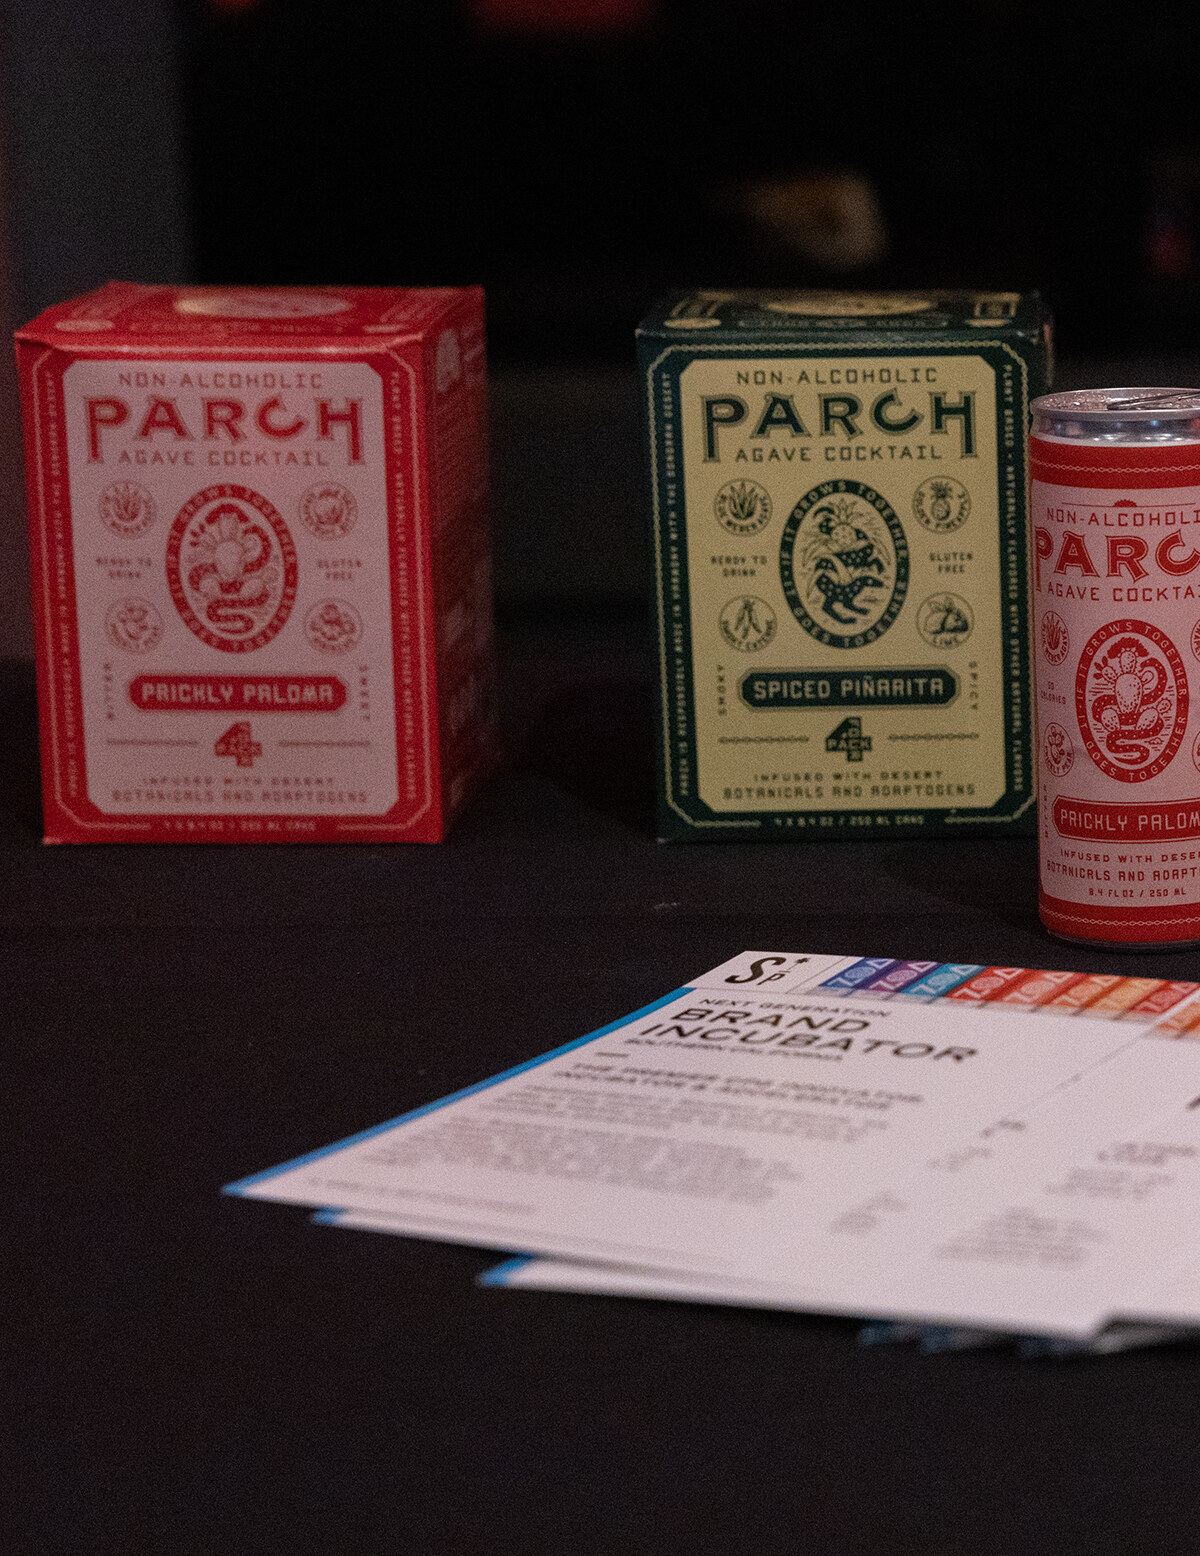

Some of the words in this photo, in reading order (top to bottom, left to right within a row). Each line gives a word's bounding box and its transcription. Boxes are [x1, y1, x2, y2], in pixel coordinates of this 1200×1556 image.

[118, 372, 323, 390] NON-ALCOHOLIC
[737, 367, 938, 386] NON-ALCOHOLIC
[84, 395, 366, 466] PARCH
[700, 387, 978, 464] PARCH
[118, 450, 196, 467] AGAVE
[207, 450, 329, 467] COCKTAIL
[735, 448, 812, 463] AGAVE
[825, 445, 942, 461] COCKTAIL
[1047, 581, 1100, 602] AGAVE
[1086, 621, 1133, 656] GROWS
[141, 683, 233, 703] PRICKLY
[243, 684, 334, 703] PALOMA
[753, 679, 831, 700] SPICED
[841, 675, 945, 699] PIÑARITA
[1086, 741, 1117, 777] GOES
[1129, 716, 1187, 782] TOGETHER
[1060, 808, 1128, 832] PRICKLY
[1060, 849, 1110, 863] INFUSED
[1118, 855, 1153, 863] WITH
[1047, 860, 1111, 881] BOTANICALS
[1119, 870, 1145, 882] AND
[1088, 887, 1103, 897] 8.4
[1150, 888, 1169, 897] 250
[1174, 887, 1187, 897] ML
[670, 1007, 870, 1033] BRAND
[639, 1024, 978, 1063] INCUBATOR
